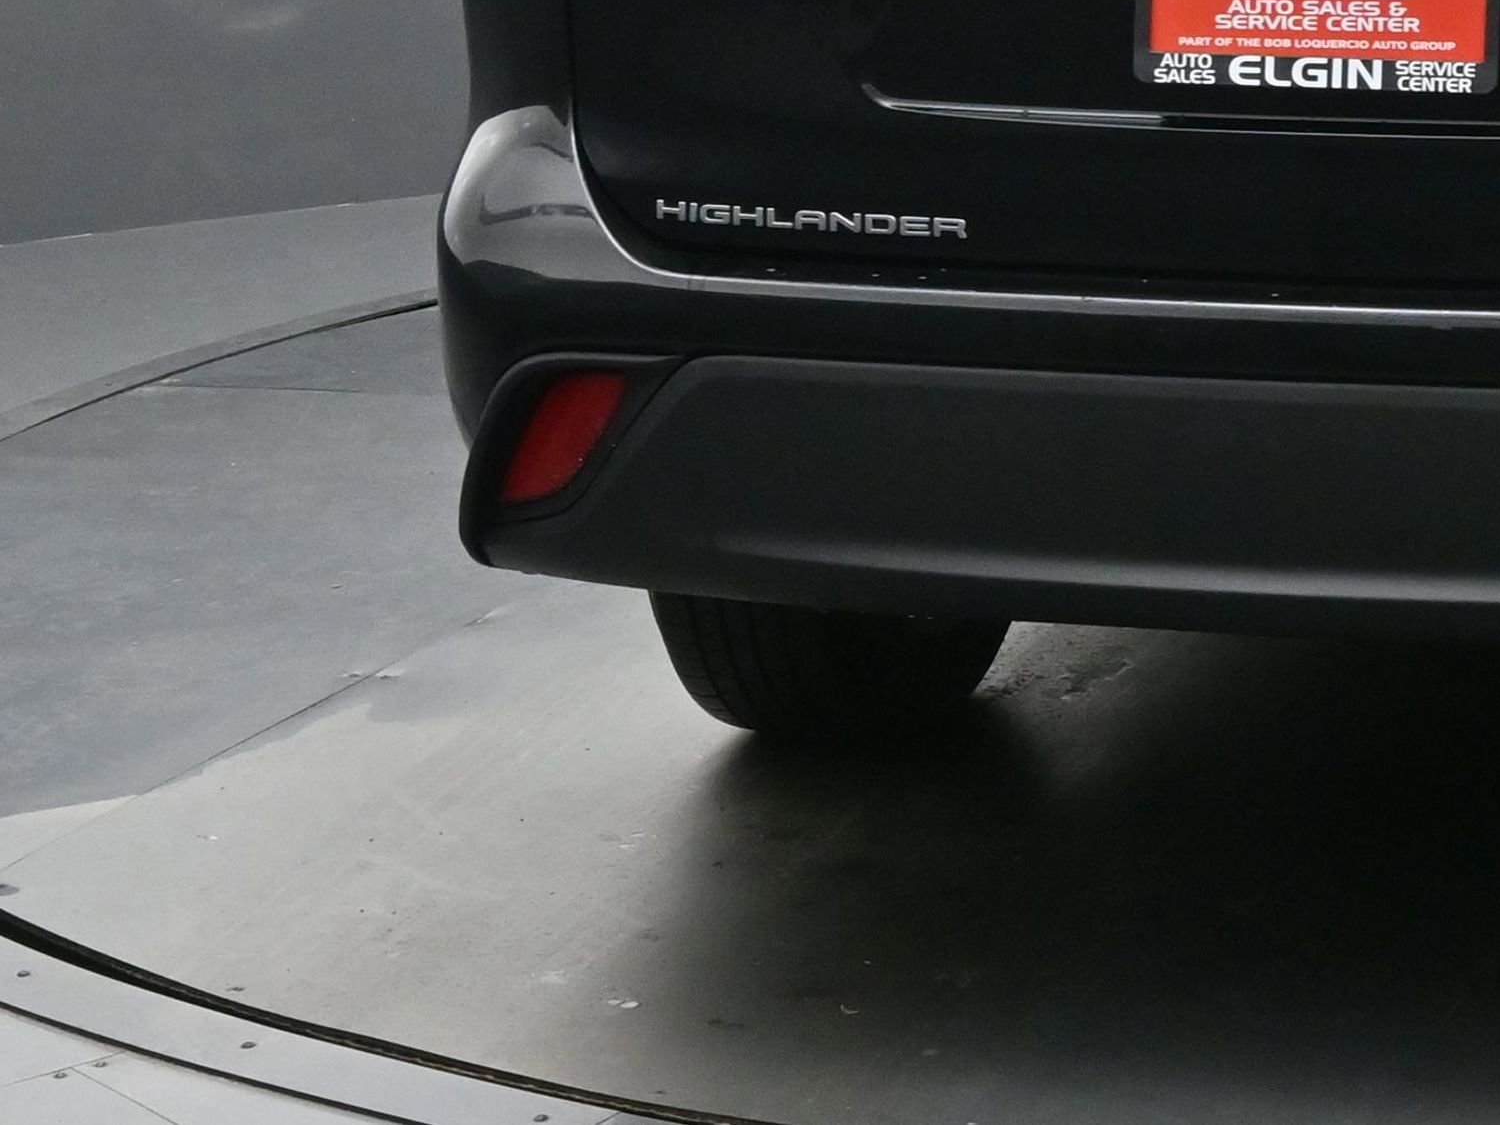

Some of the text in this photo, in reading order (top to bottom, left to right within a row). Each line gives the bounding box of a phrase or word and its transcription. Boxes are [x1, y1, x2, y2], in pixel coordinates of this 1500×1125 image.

[1226, 0, 1407, 16] AUTO SALES &
[1215, 15, 1420, 33] SERVICE CENTER
[1178, 36, 1456, 51] PART OF THE BOB LOQUERCIO AUTO GROUP
[1160, 53, 1212, 69] AUTO
[1395, 61, 1477, 78] SERVICE
[1153, 68, 1216, 85] SALES
[1228, 55, 1382, 90] ELGIN
[1397, 76, 1472, 93] CENTER
[656, 199, 967, 238] HIGHLANDER
